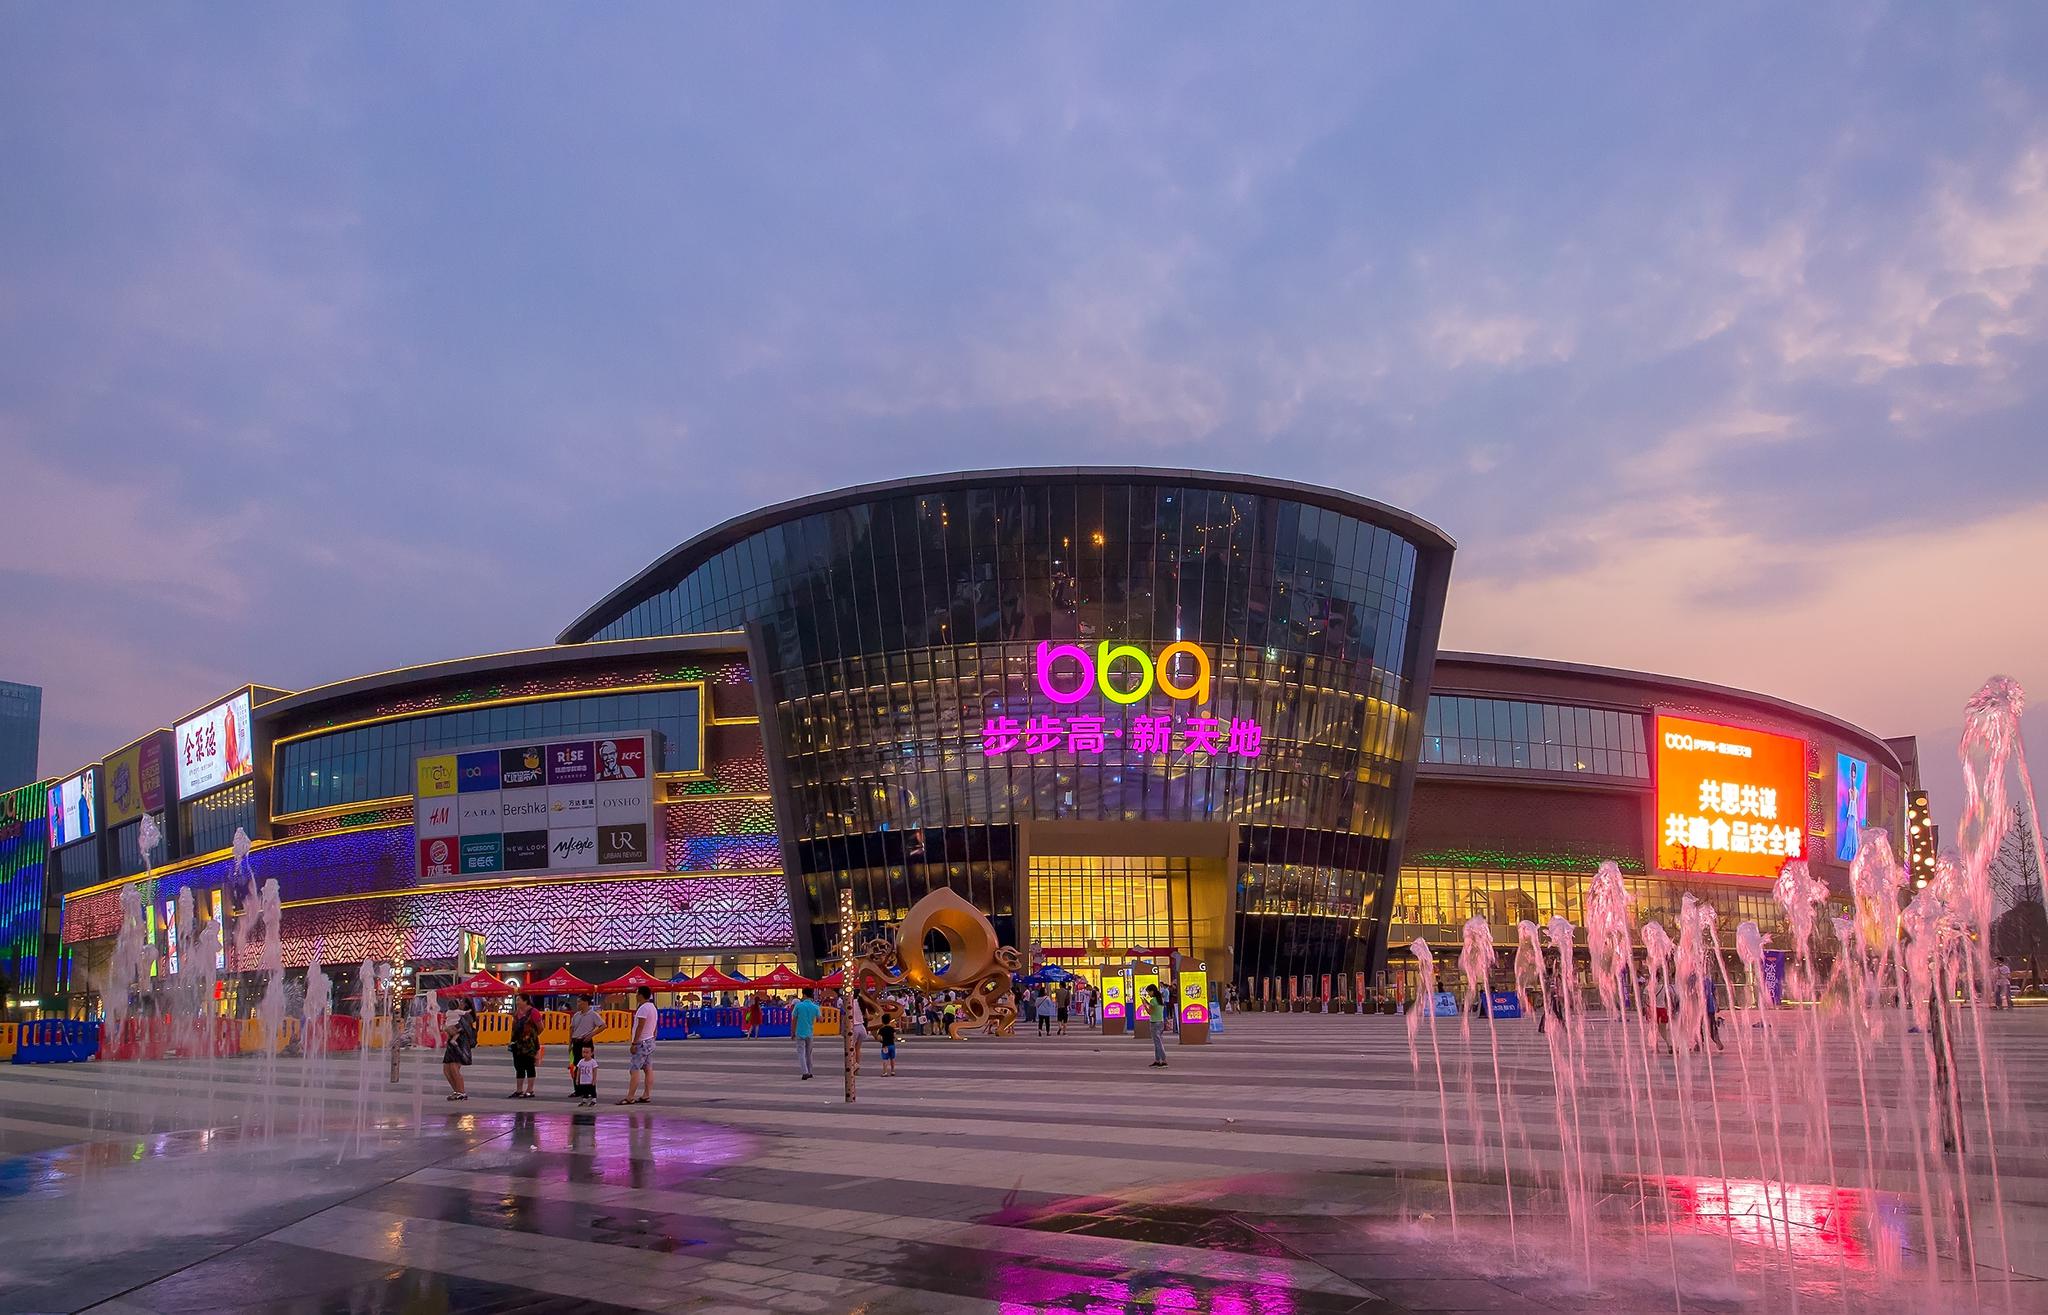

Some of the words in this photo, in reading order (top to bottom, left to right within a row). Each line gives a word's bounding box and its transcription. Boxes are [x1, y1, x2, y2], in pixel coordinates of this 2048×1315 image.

[982, 713, 1262, 758] 步步高·新天地
[622, 751, 642, 761] KFC
[603, 798, 641, 808] OYSHO
[1699, 779, 1777, 819] 共思共谋
[464, 809, 496, 818] ZARA
[503, 802, 547, 816] Bershka
[429, 807, 450, 826] H&M
[610, 831, 635, 850] UR
[1665, 813, 1801, 858] 共建食品安全城
[1152, 966, 1158, 974] G
[1199, 962, 1207, 971] G
[1117, 969, 1124, 977] G
